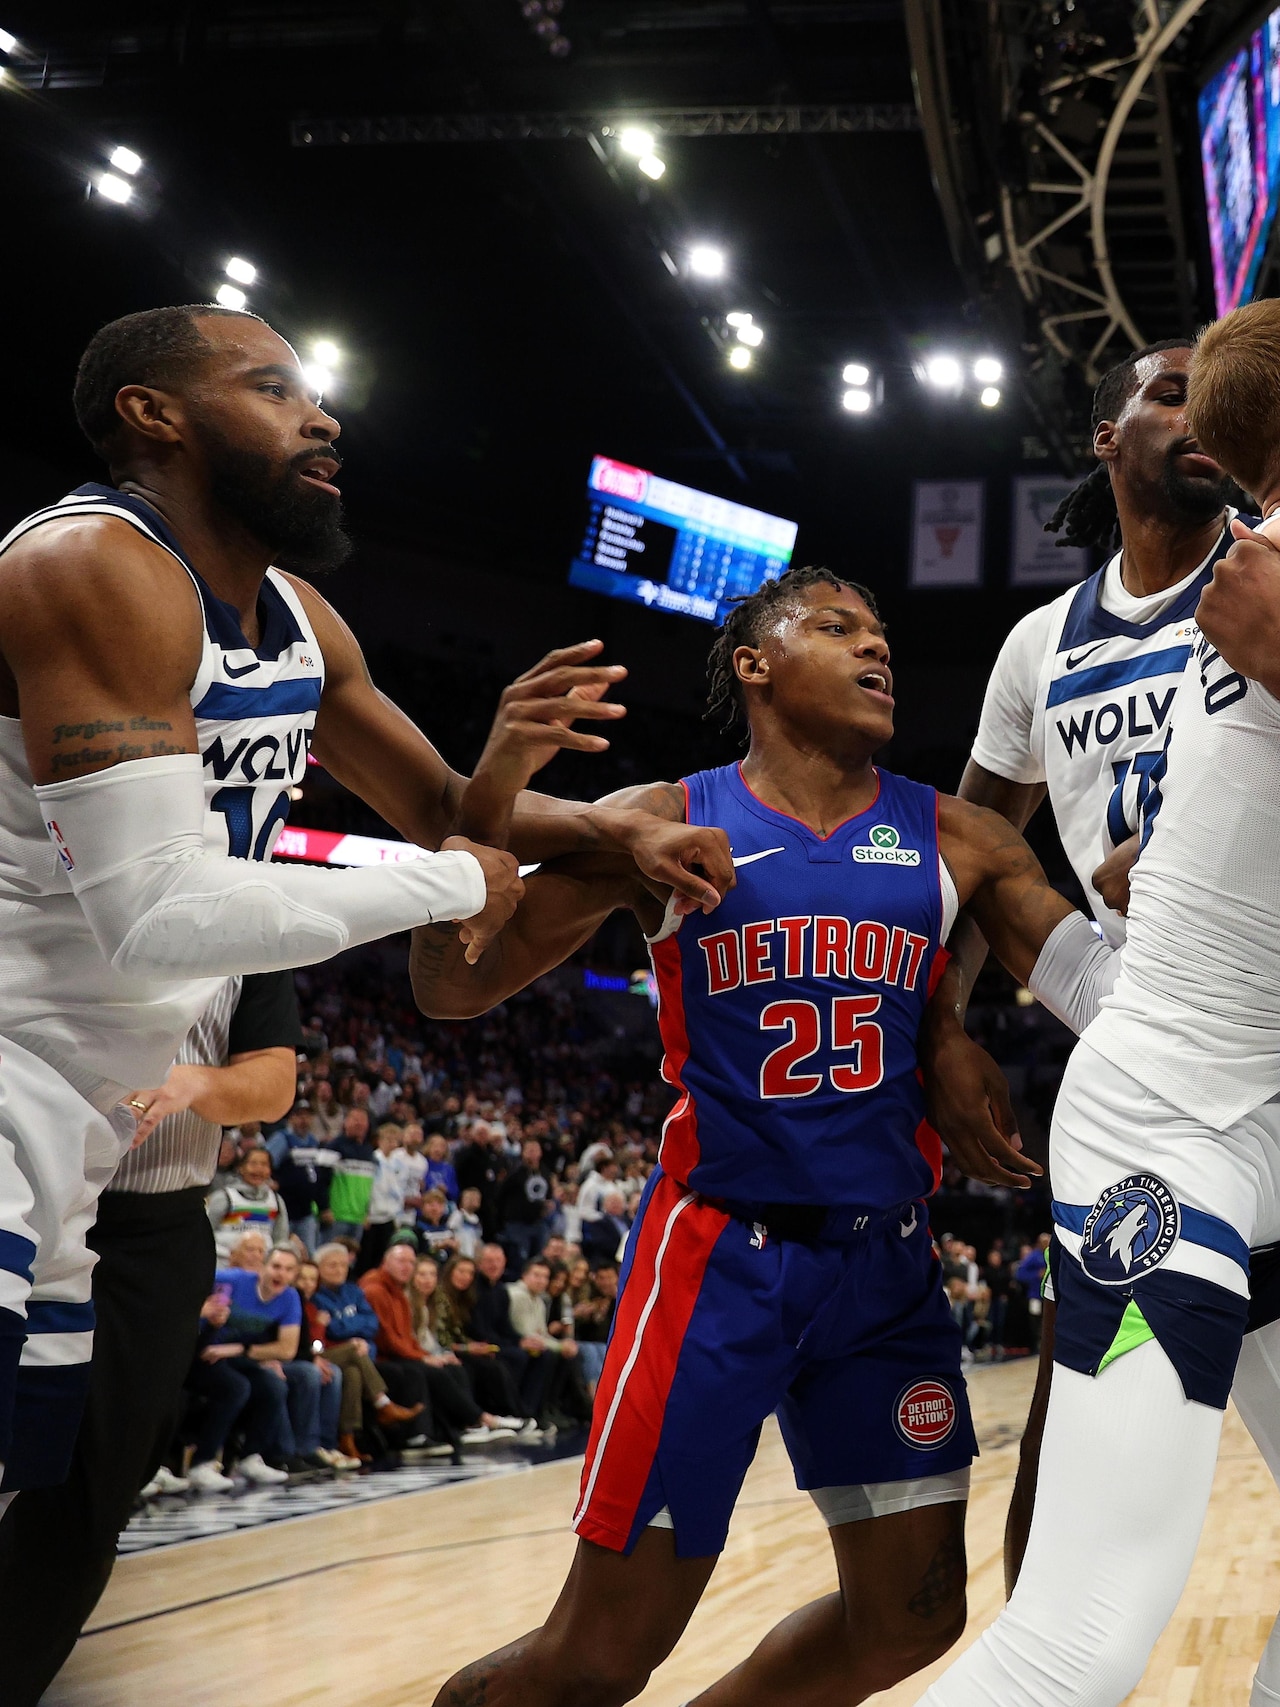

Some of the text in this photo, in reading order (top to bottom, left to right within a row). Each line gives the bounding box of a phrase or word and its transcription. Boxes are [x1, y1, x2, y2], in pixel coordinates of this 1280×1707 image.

[855, 848, 917, 864] StockX
[698, 915, 929, 996] DETROIT
[760, 994, 884, 1099] 25
[1084, 1177, 1176, 1267] MINNESOTA TIMBERWOLVES
[907, 1398, 947, 1415] DETROIT
[908, 1409, 948, 1427] PISTONS
